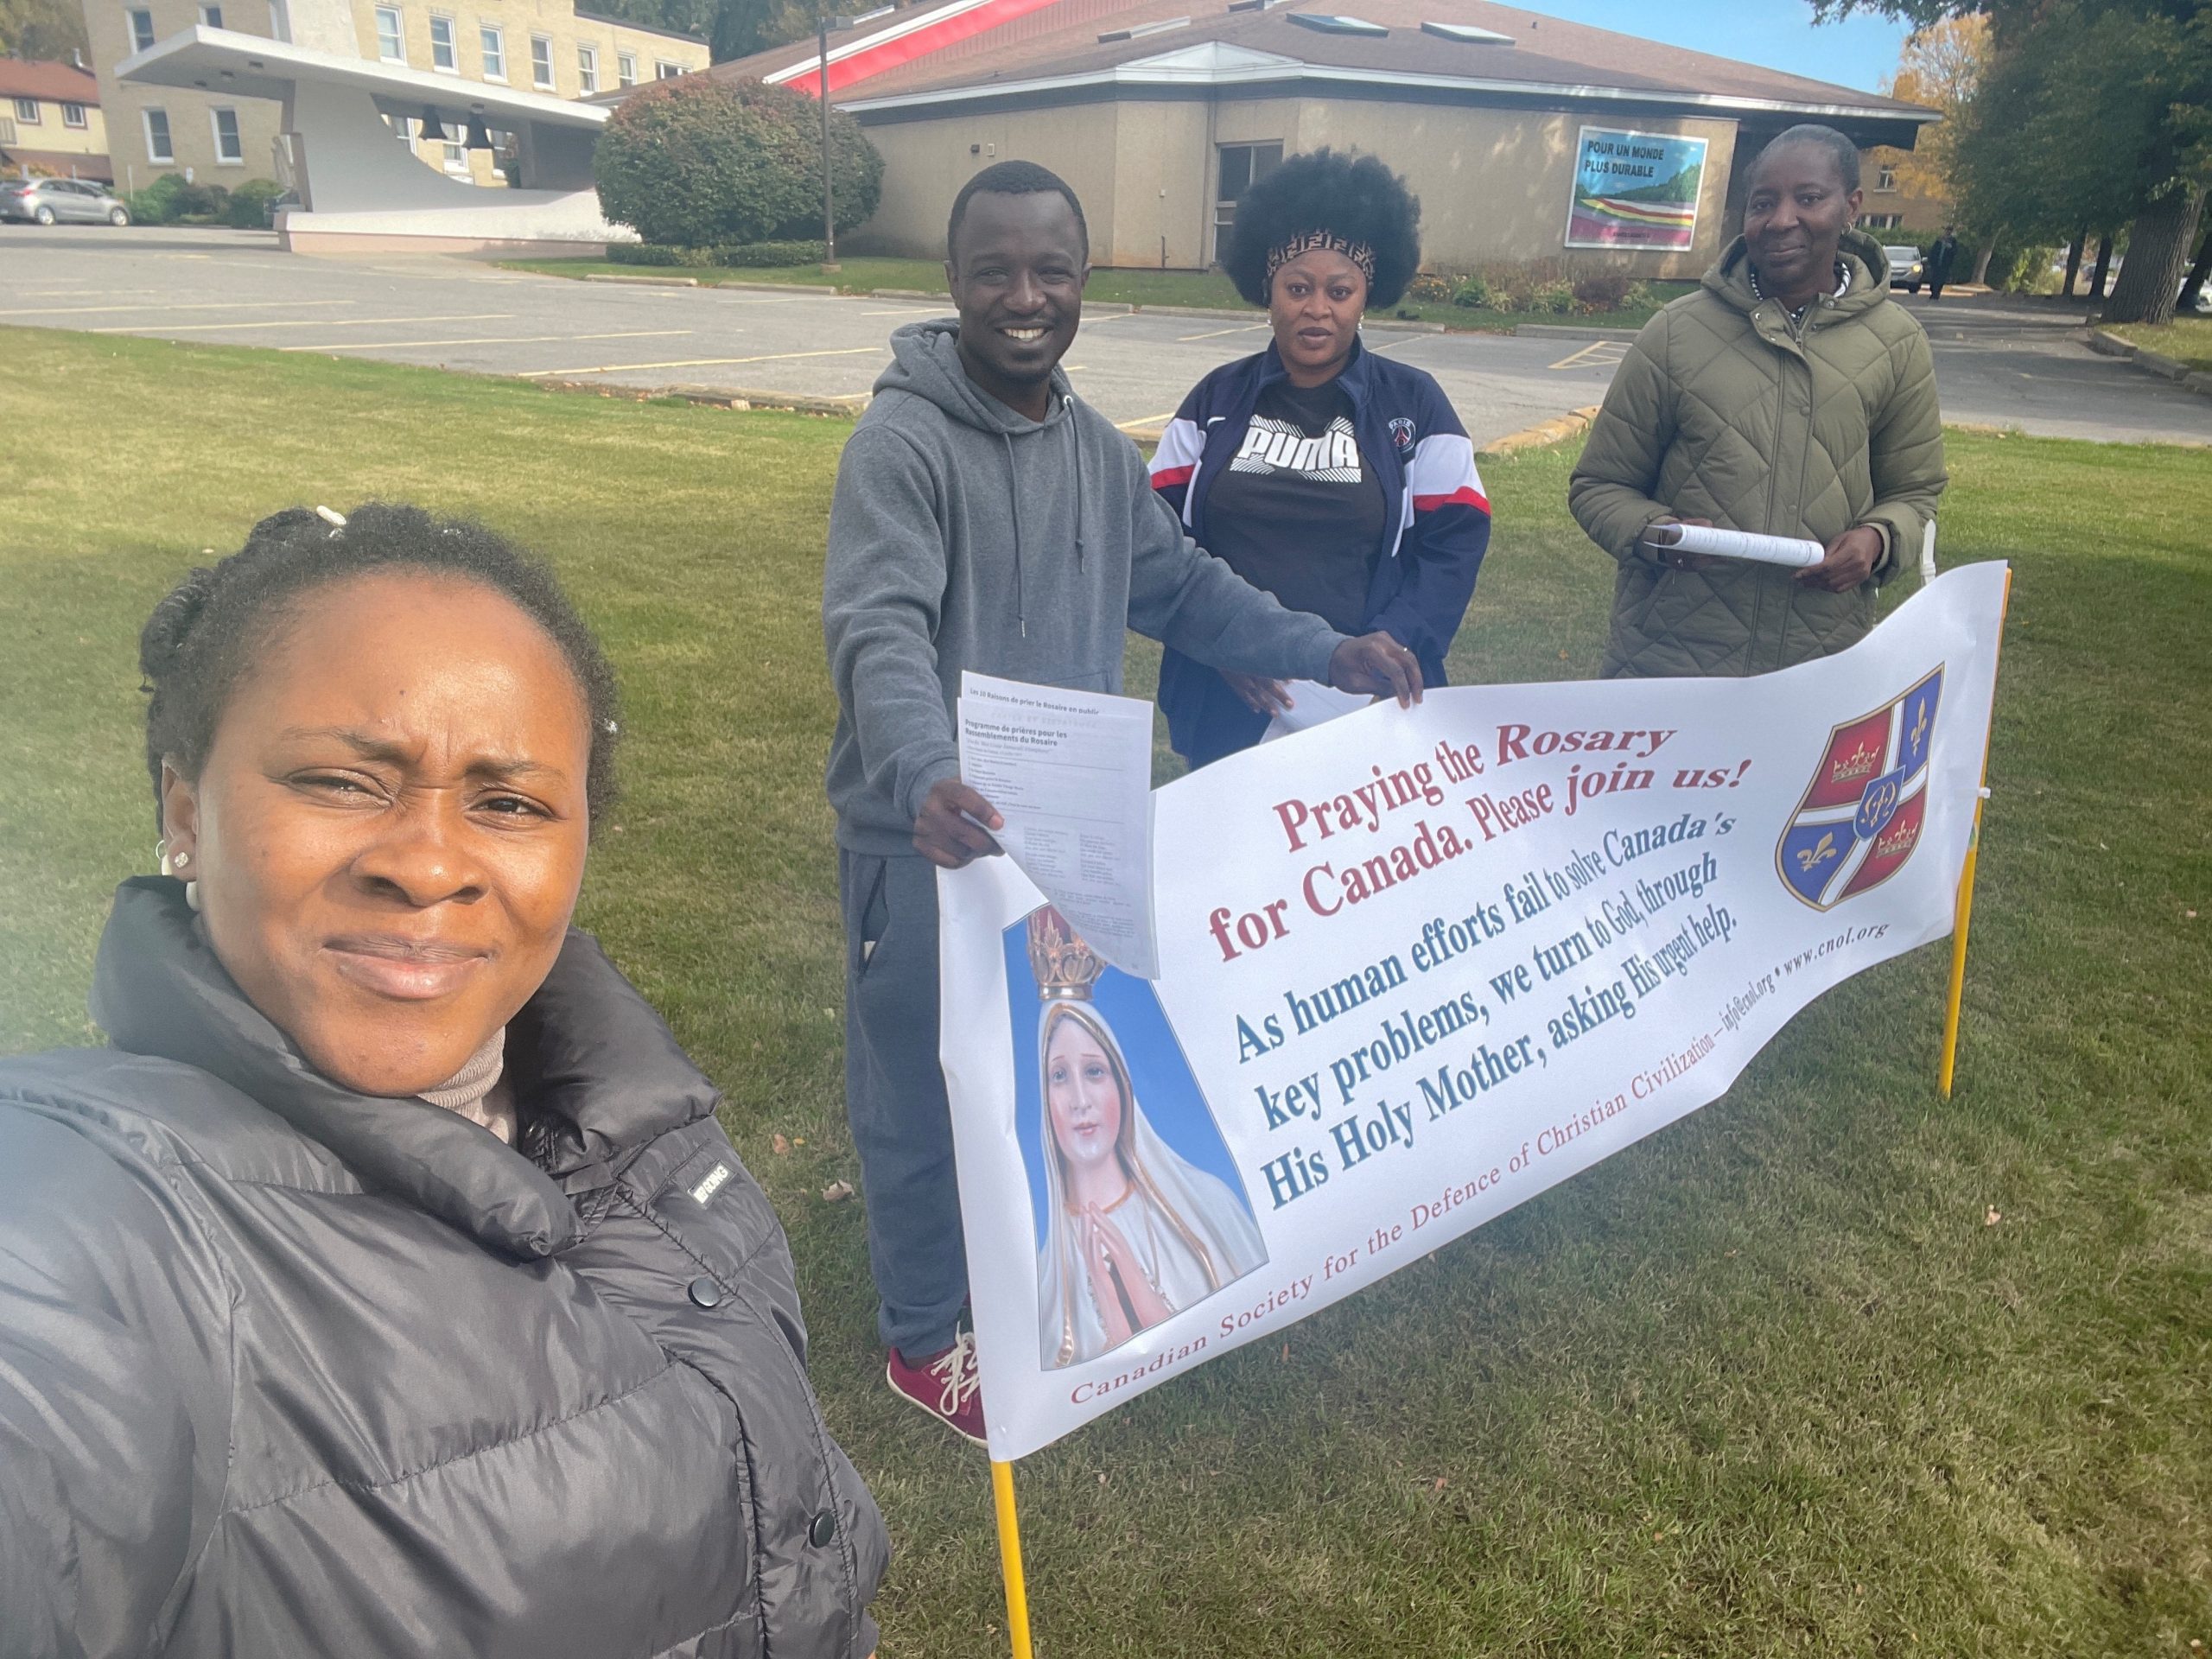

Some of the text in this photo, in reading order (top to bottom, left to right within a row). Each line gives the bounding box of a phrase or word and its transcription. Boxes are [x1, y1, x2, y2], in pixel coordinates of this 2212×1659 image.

[1584, 160, 1655, 178] PLUS DURABLE
[1587, 141, 1664, 160] POUR UN MONDE
[1236, 426, 1360, 471] PUMA
[965, 718, 1000, 733] Programme
[1001, 724, 1009, 733] de
[1011, 725, 1037, 737] prières
[1038, 731, 1055, 740] pour
[1057, 729, 1068, 739] les
[965, 728, 1058, 747] Rassemblements du Rosaire
[969, 688, 979, 696] Les
[987, 691, 1009, 702] Raisons
[1019, 698, 1035, 708] prier
[1036, 700, 1042, 709] le
[1043, 702, 1067, 712] Rosaire
[1272, 724, 1678, 854] Praying the Rosary
[1210, 759, 1752, 963] for Canada. Please join us!
[1236, 811, 1738, 1065] As human efforts fail to solve Canada's
[1254, 851, 1718, 1132] key problems, we turn to God, through
[1260, 903, 1738, 1211] His Holy Mother, asking His urgent help.
[1071, 1334, 1208, 1405] Canadian
[1219, 1274, 1315, 1340] Society
[1323, 1247, 1358, 1281] for
[1367, 1223, 1403, 1255] the
[1409, 1166, 1502, 1231] Defence
[1509, 1141, 1532, 1174] of
[1536, 1093, 1628, 1156] Christian
[1631, 1033, 1716, 1100] Civilization
[1783, 923, 1891, 976] www.cnol.org
